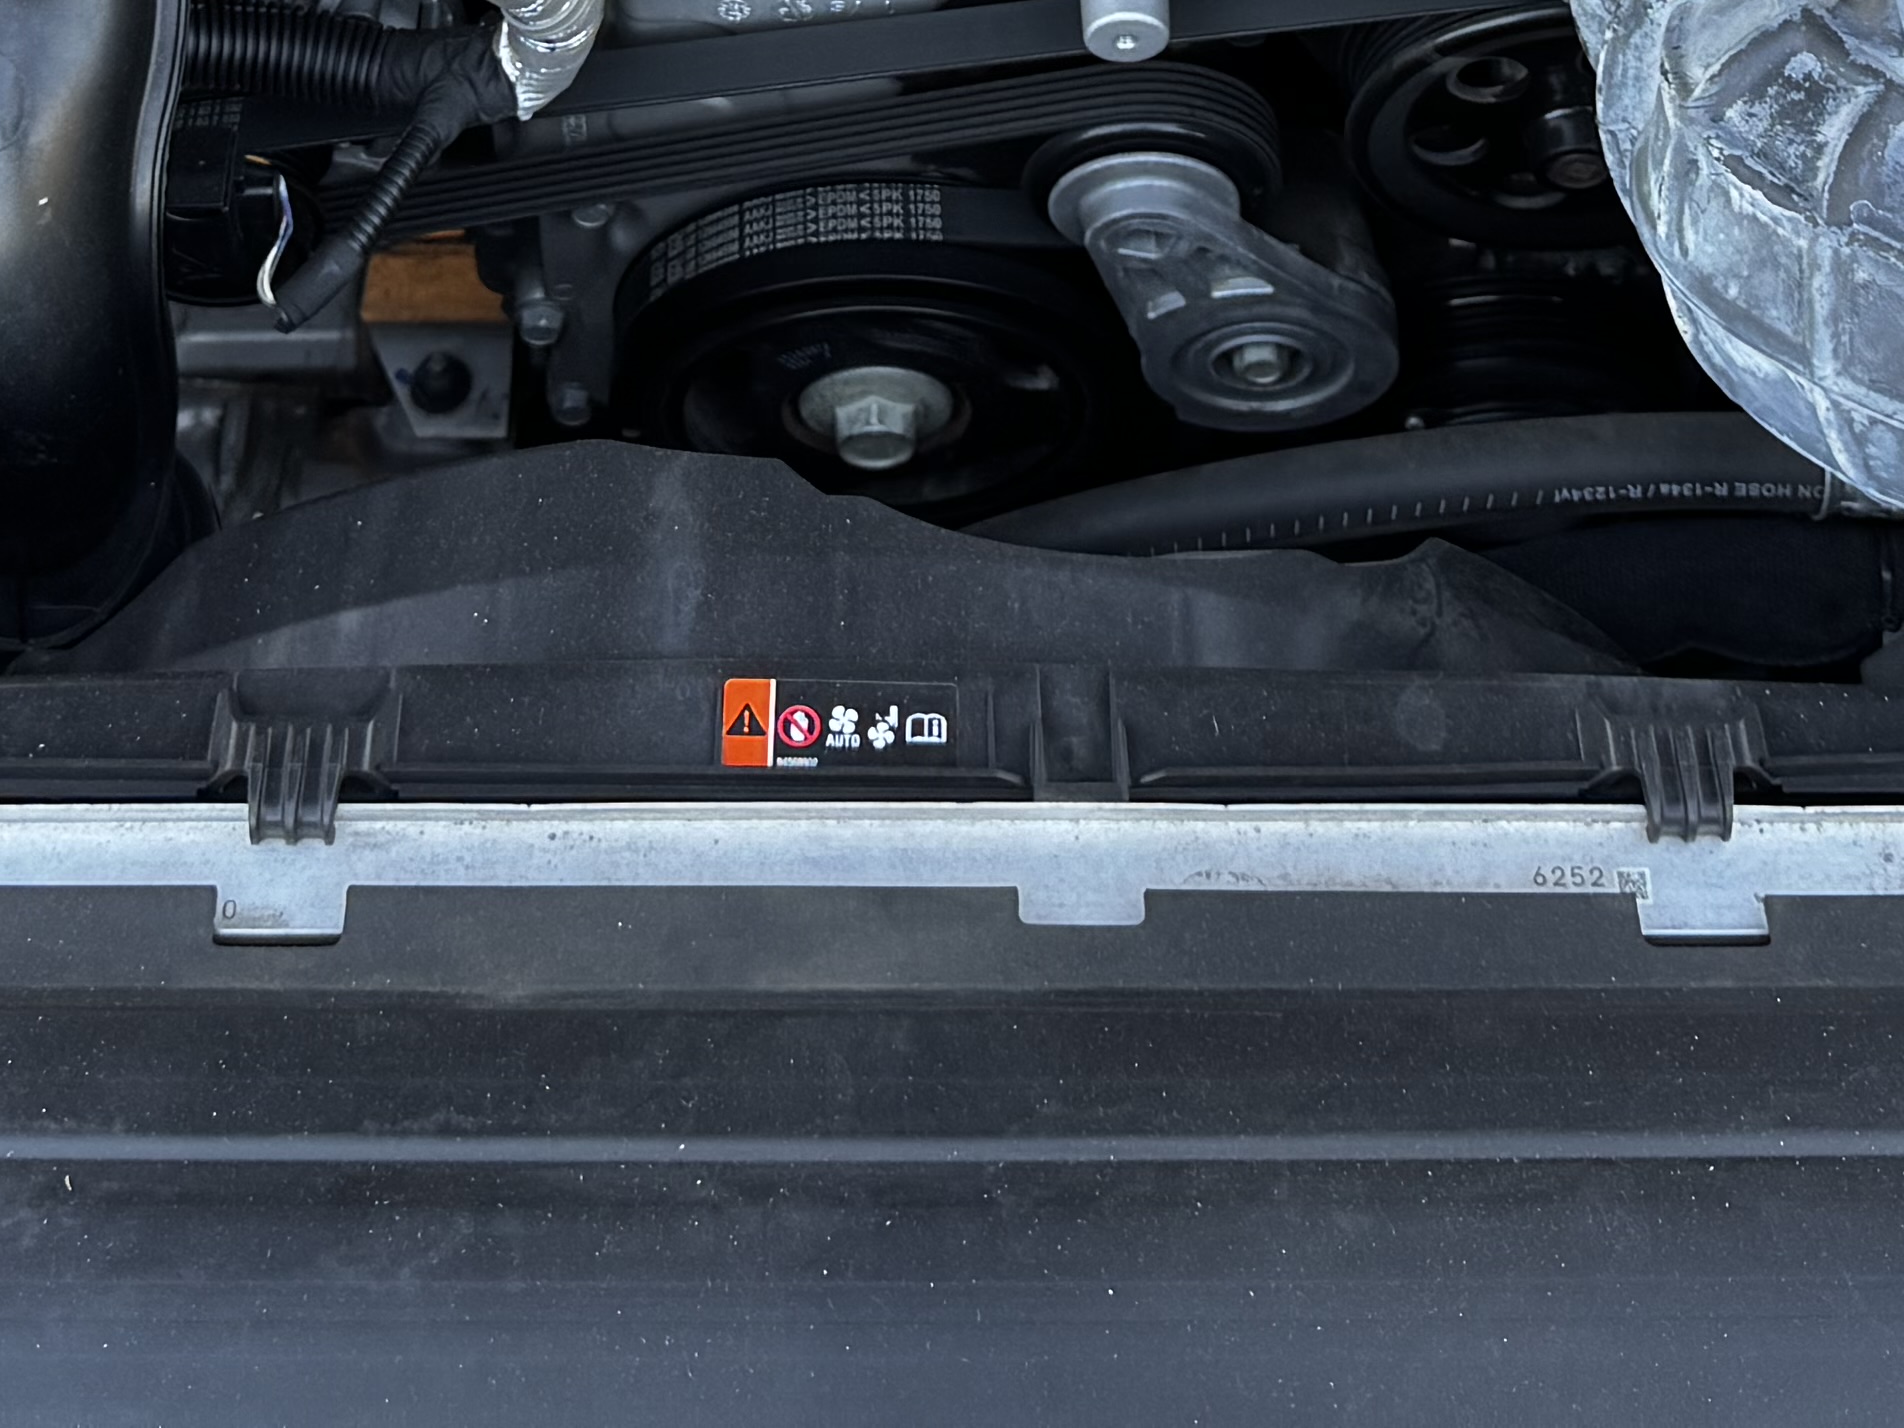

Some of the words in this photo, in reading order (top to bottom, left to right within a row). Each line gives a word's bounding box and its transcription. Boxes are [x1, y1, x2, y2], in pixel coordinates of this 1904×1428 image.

[1733, 481, 1792, 498] HOSE
[825, 733, 861, 749] AUTO
[1532, 866, 1606, 889] 6252
